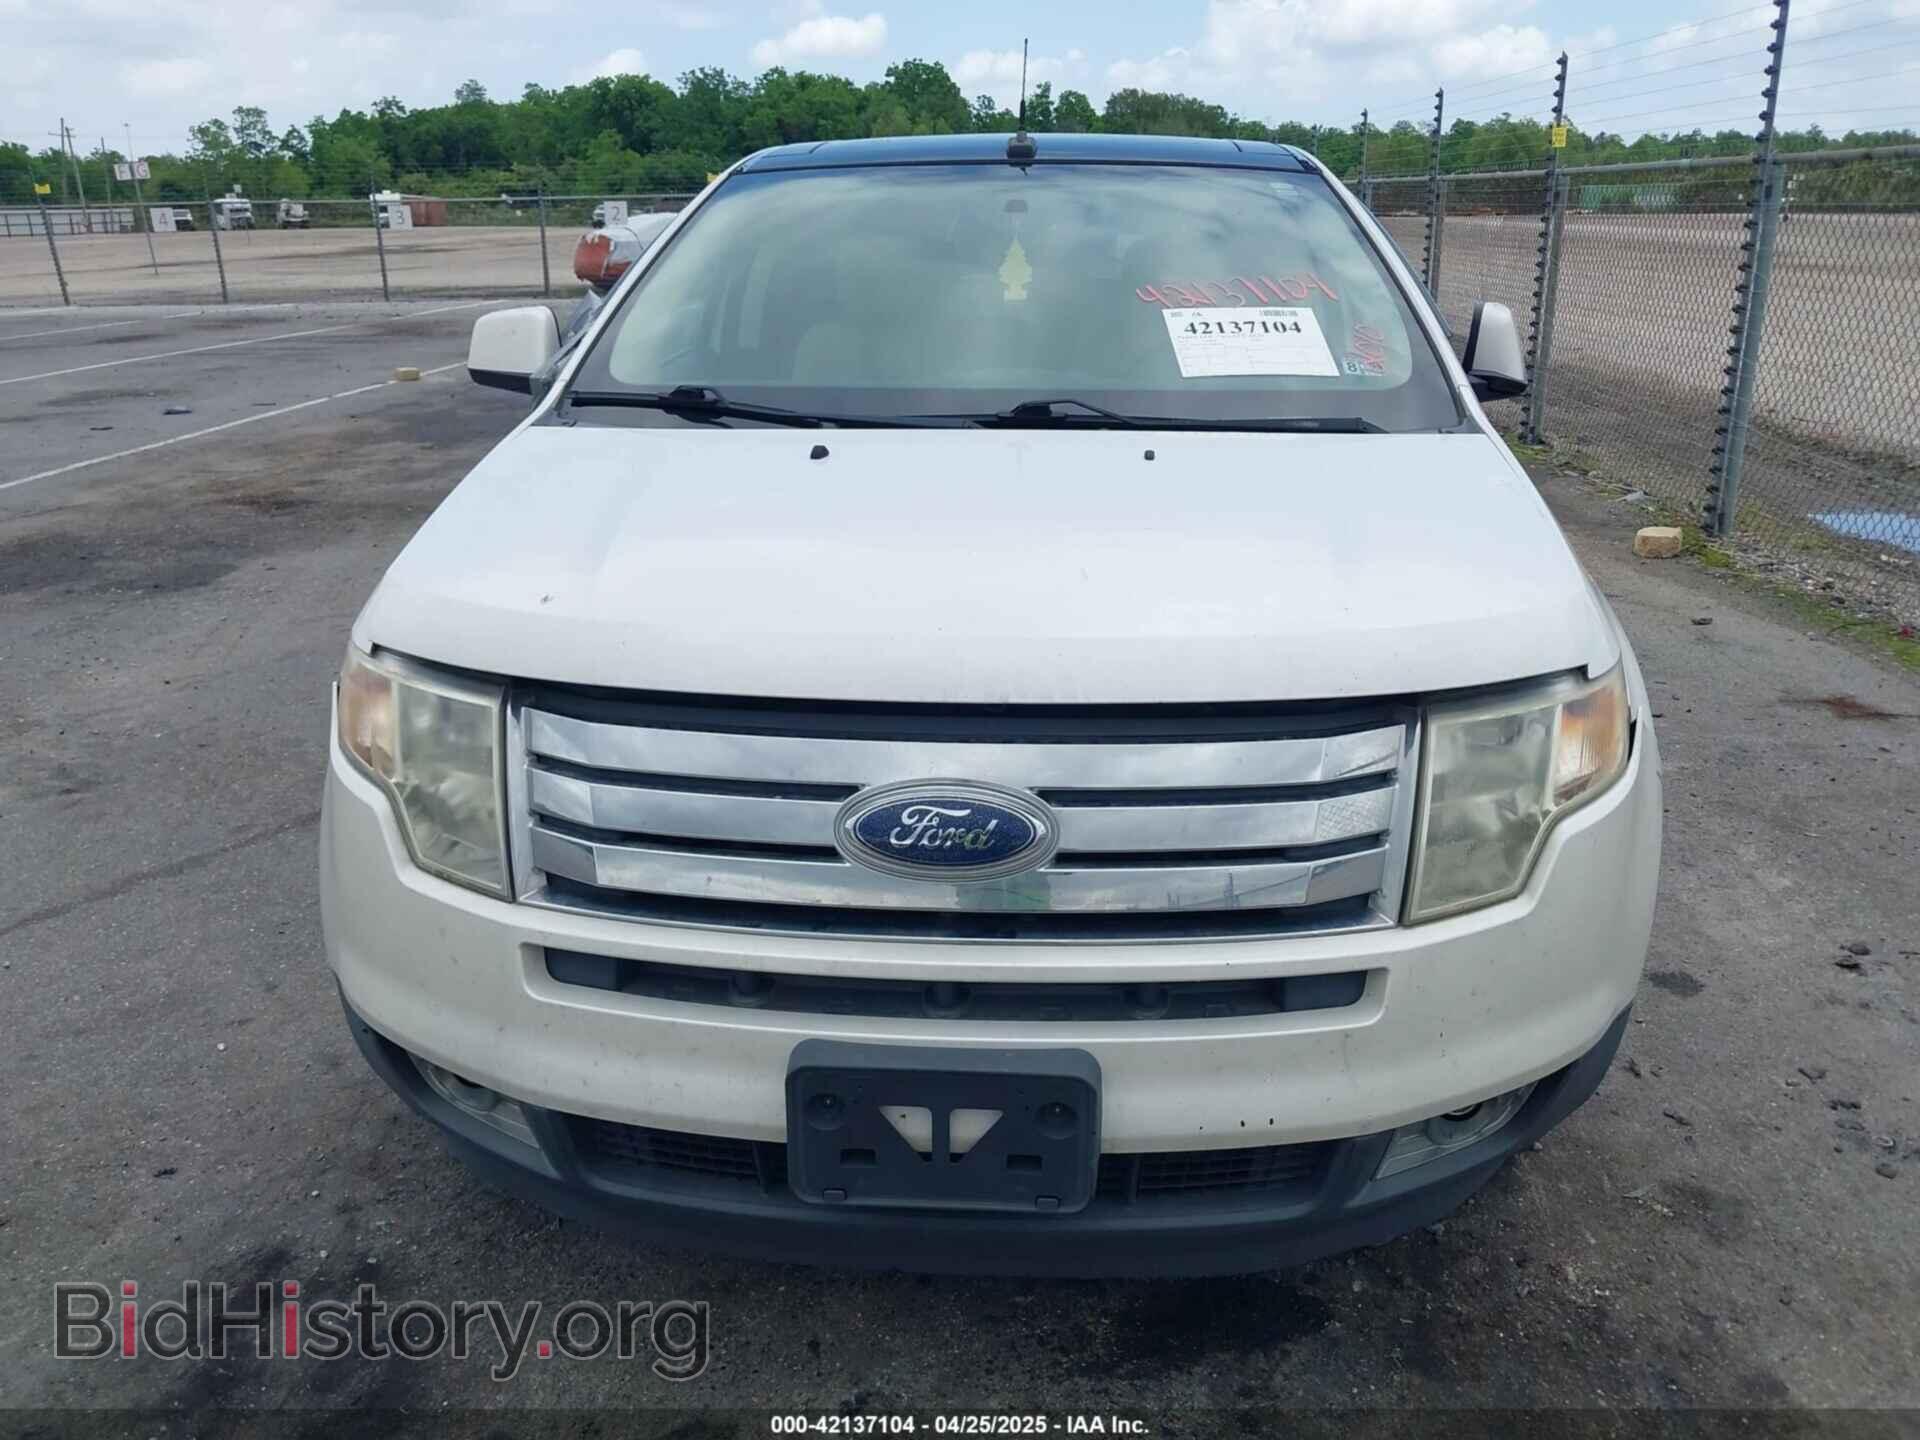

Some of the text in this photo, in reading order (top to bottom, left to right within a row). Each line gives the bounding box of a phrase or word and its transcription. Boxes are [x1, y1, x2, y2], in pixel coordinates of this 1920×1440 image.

[611, 205, 621, 222] 2
[1183, 320, 1302, 335] 42137104
[889, 804, 999, 849] Ford
